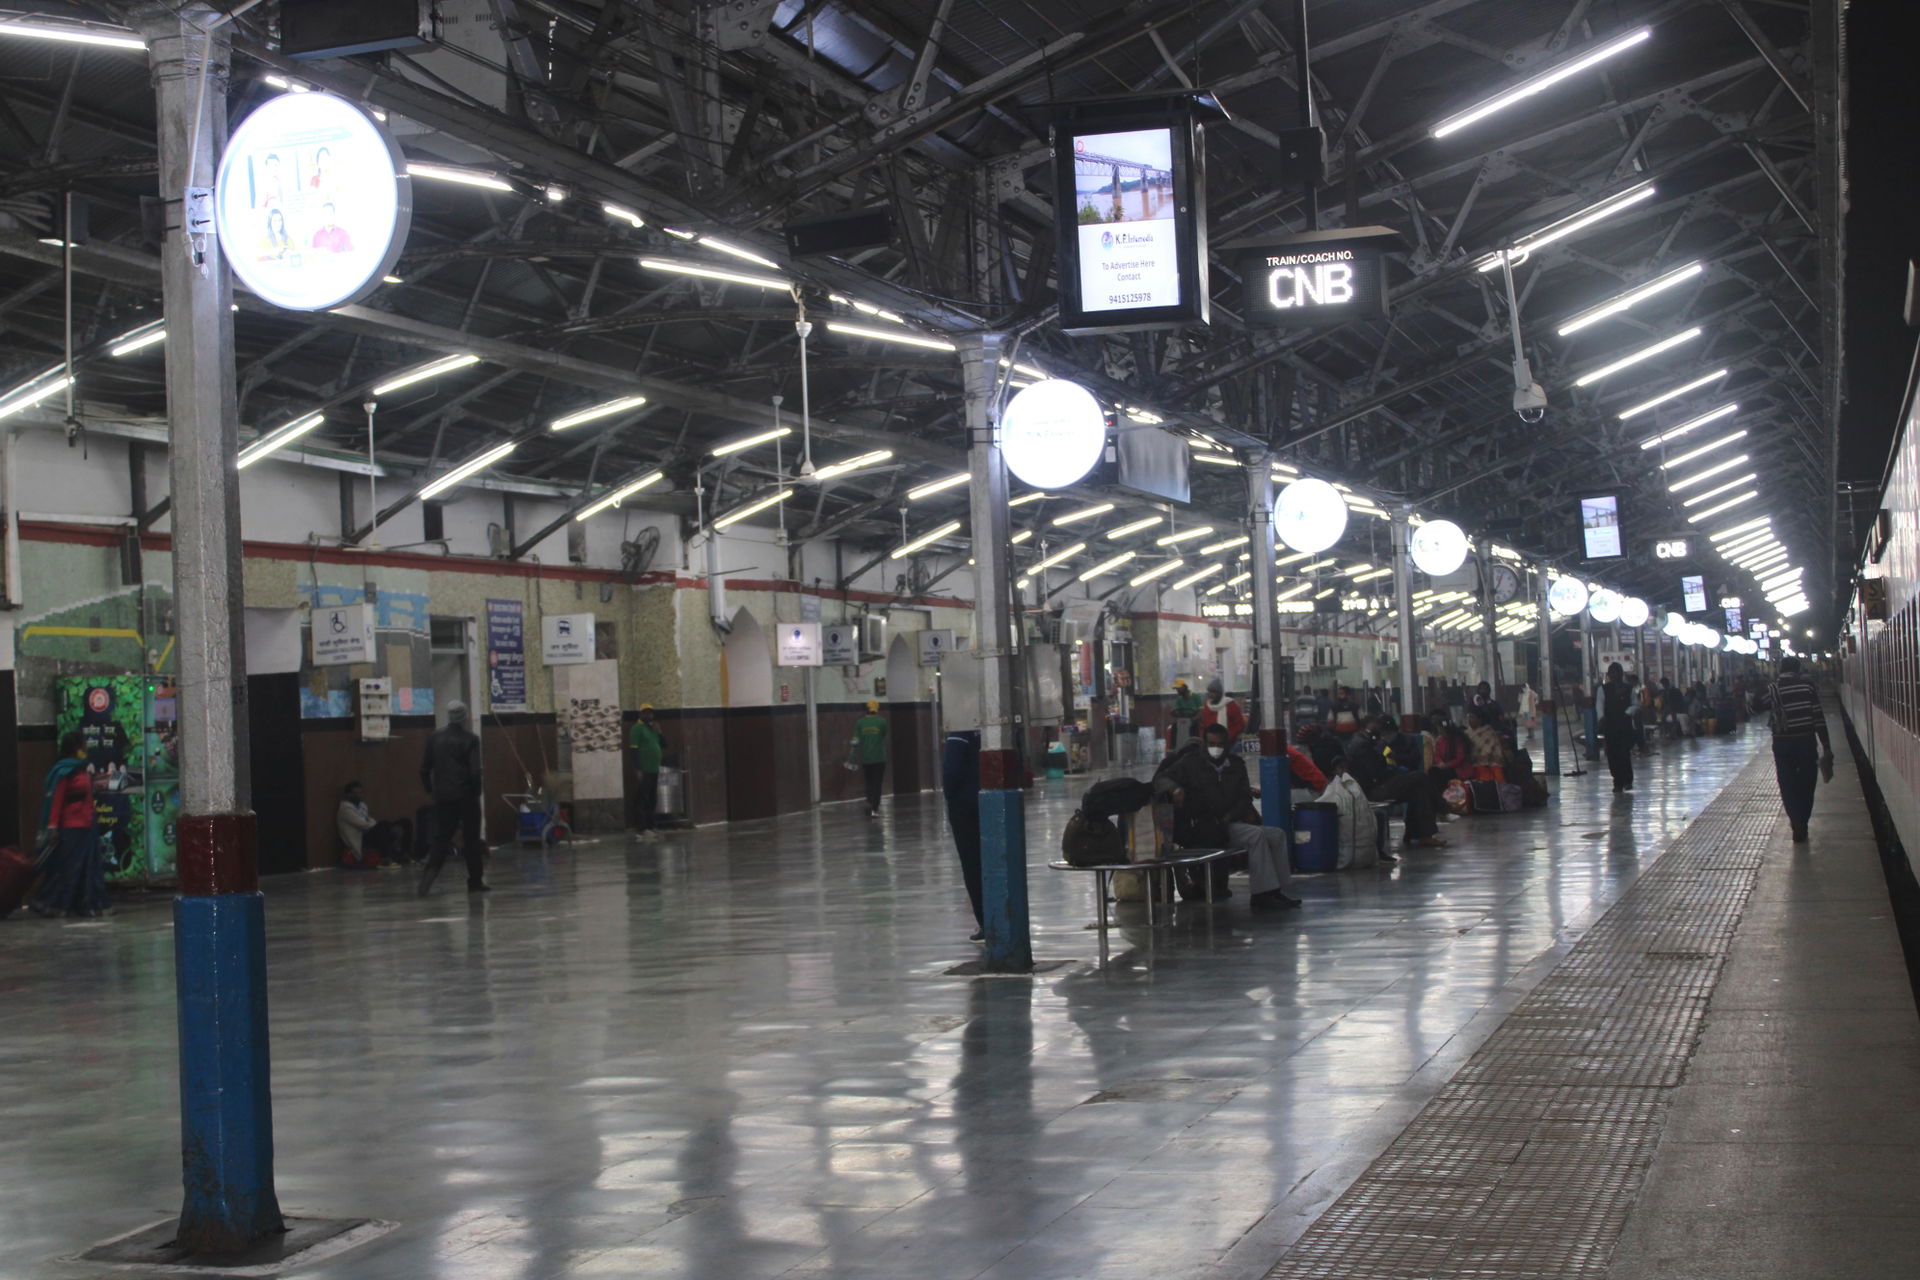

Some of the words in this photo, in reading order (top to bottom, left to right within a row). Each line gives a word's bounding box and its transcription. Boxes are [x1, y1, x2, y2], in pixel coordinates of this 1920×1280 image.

[1101, 262, 1109, 271] To
[1110, 259, 1139, 271] Advertise
[1140, 259, 1155, 269] Here
[1266, 251, 1336, 267] TRAIN/COACH
[1336, 250, 1354, 261] NO.
[1117, 273, 1142, 282] Contact
[1268, 262, 1353, 309] CNB
